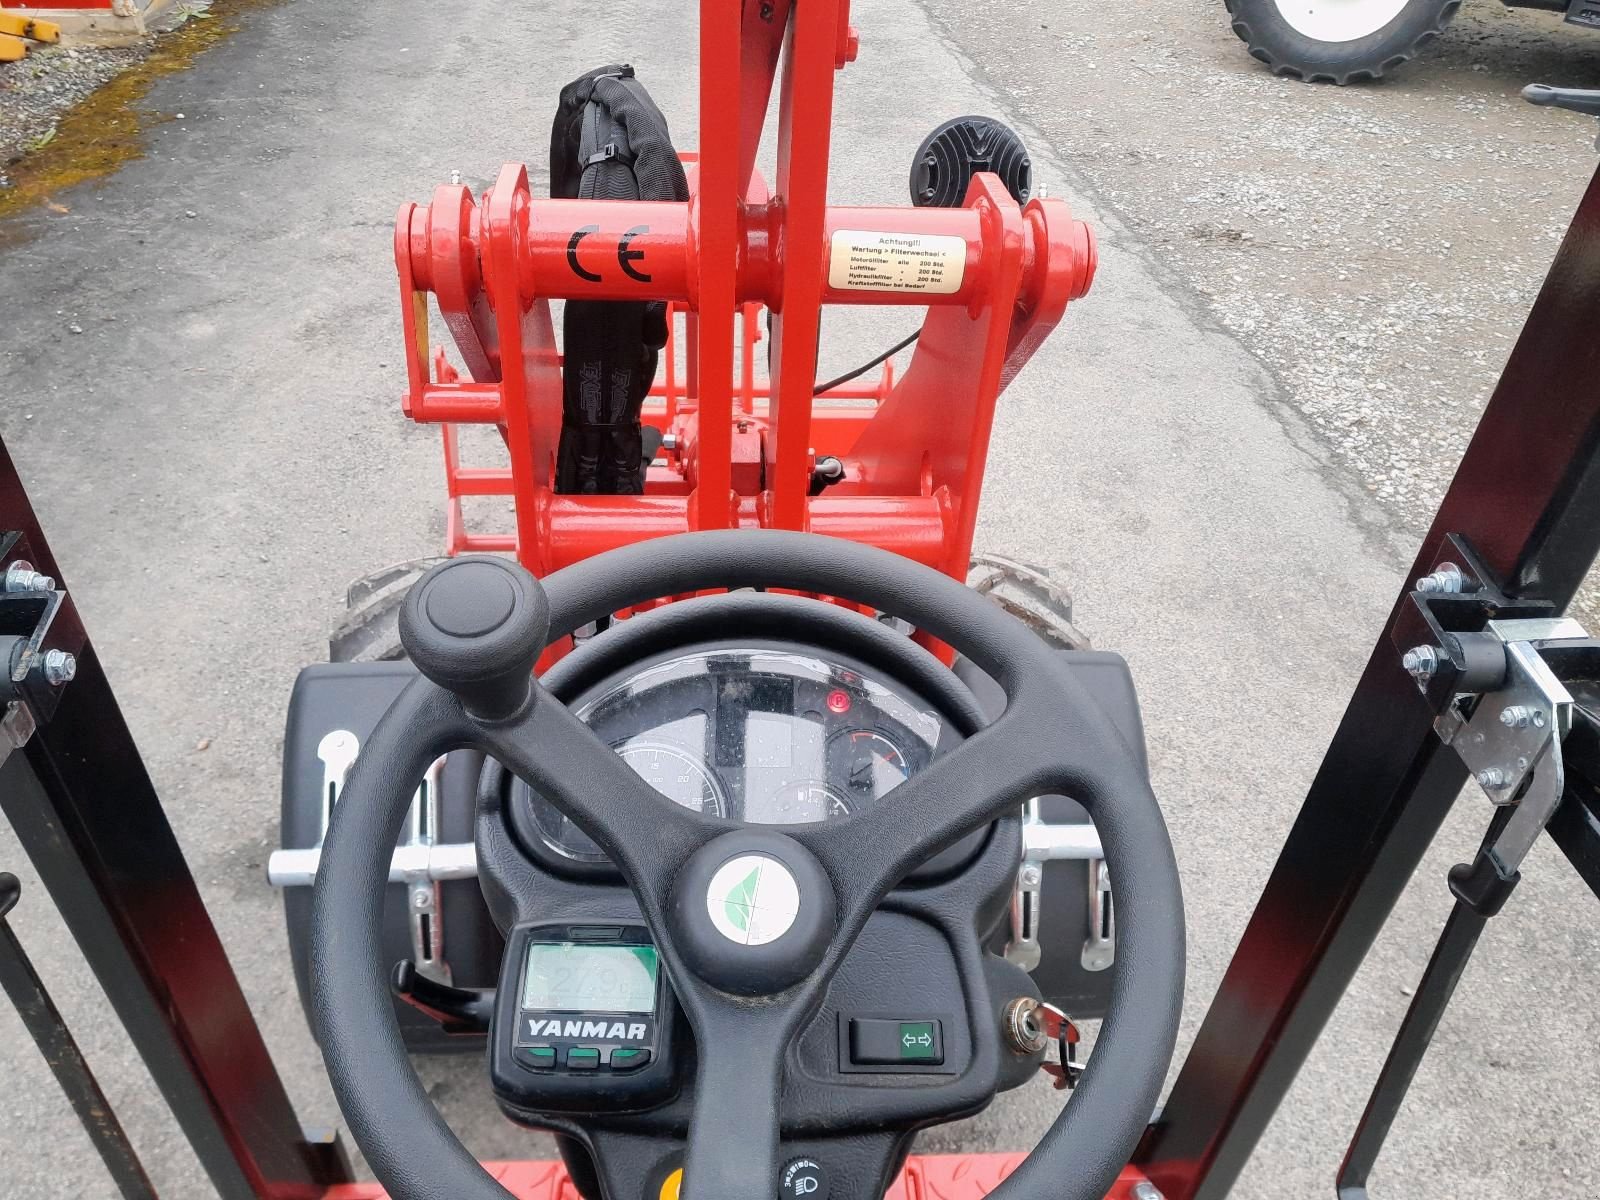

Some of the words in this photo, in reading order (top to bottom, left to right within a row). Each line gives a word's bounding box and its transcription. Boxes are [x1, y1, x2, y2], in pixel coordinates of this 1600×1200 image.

[566, 224, 652, 283] CE
[851, 245, 882, 255] Wartung
[890, 248, 940, 257] Filterwechsel
[849, 264, 877, 272] Luftfilter
[848, 272, 893, 281] Hydraulikfilter
[677, 775, 690, 783] 20
[528, 1019, 647, 1040] YANMAR
